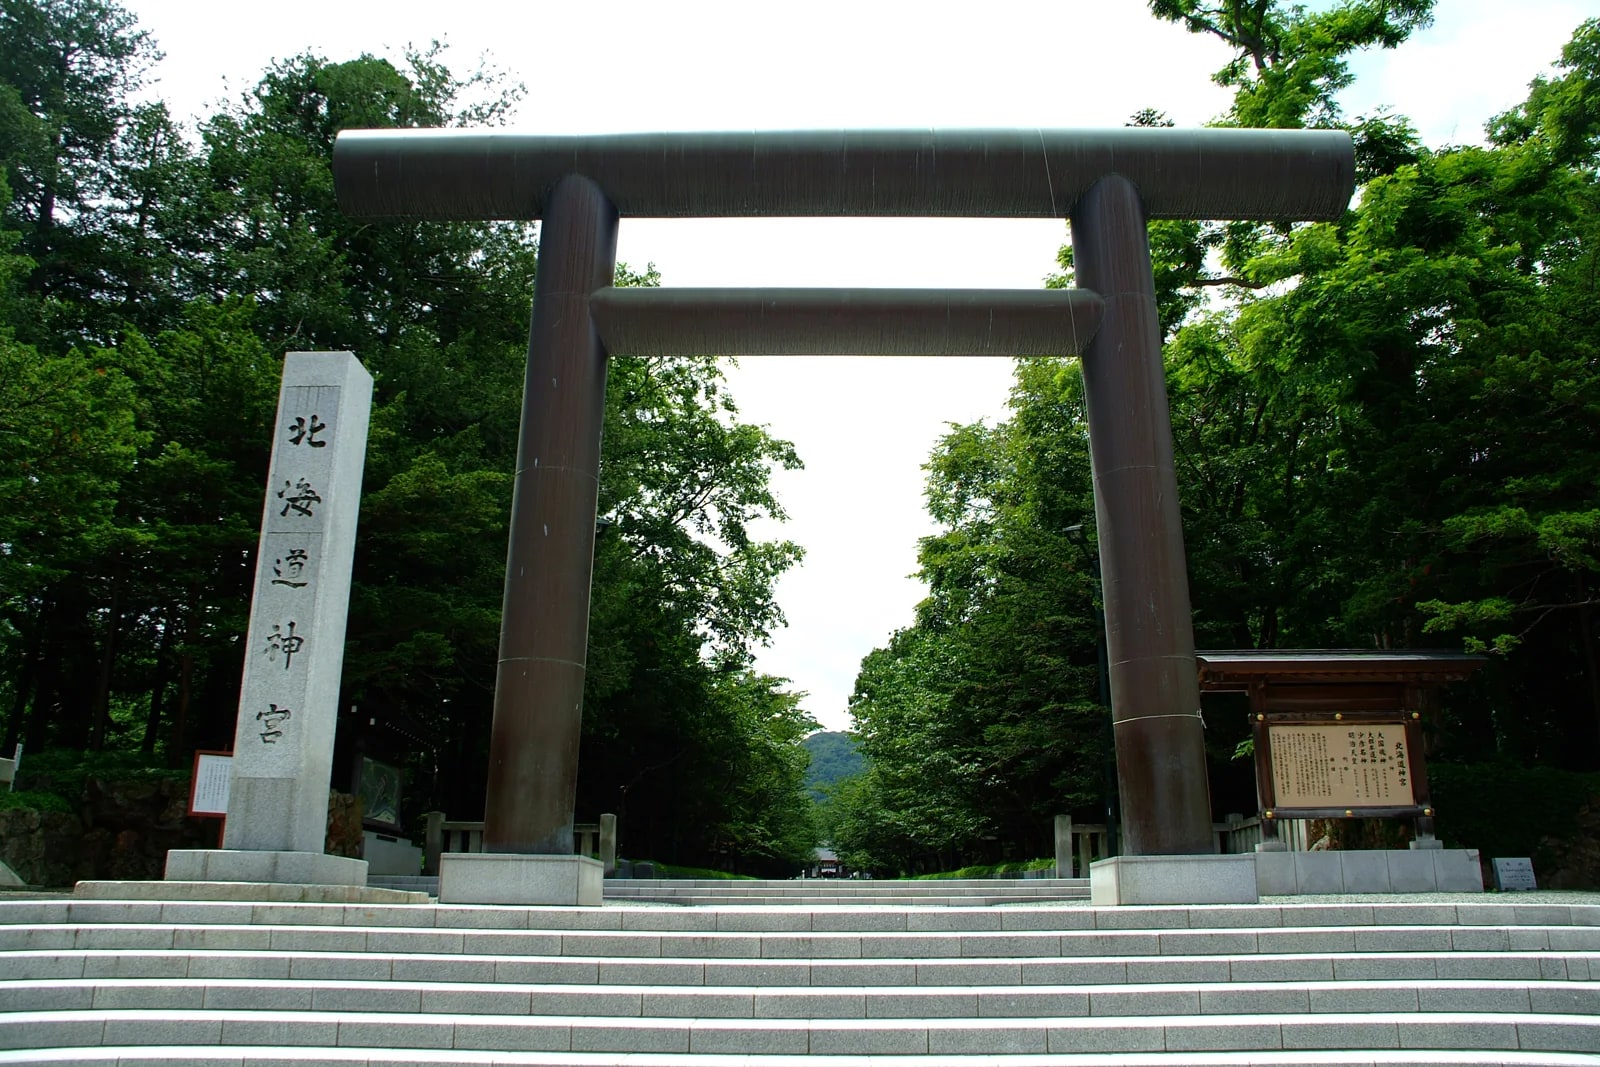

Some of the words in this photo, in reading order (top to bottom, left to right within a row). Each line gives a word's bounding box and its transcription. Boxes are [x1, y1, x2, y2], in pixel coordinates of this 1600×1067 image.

[256, 414, 327, 744] 北海道神宮
[1395, 742, 1406, 786] 北海道神宮
